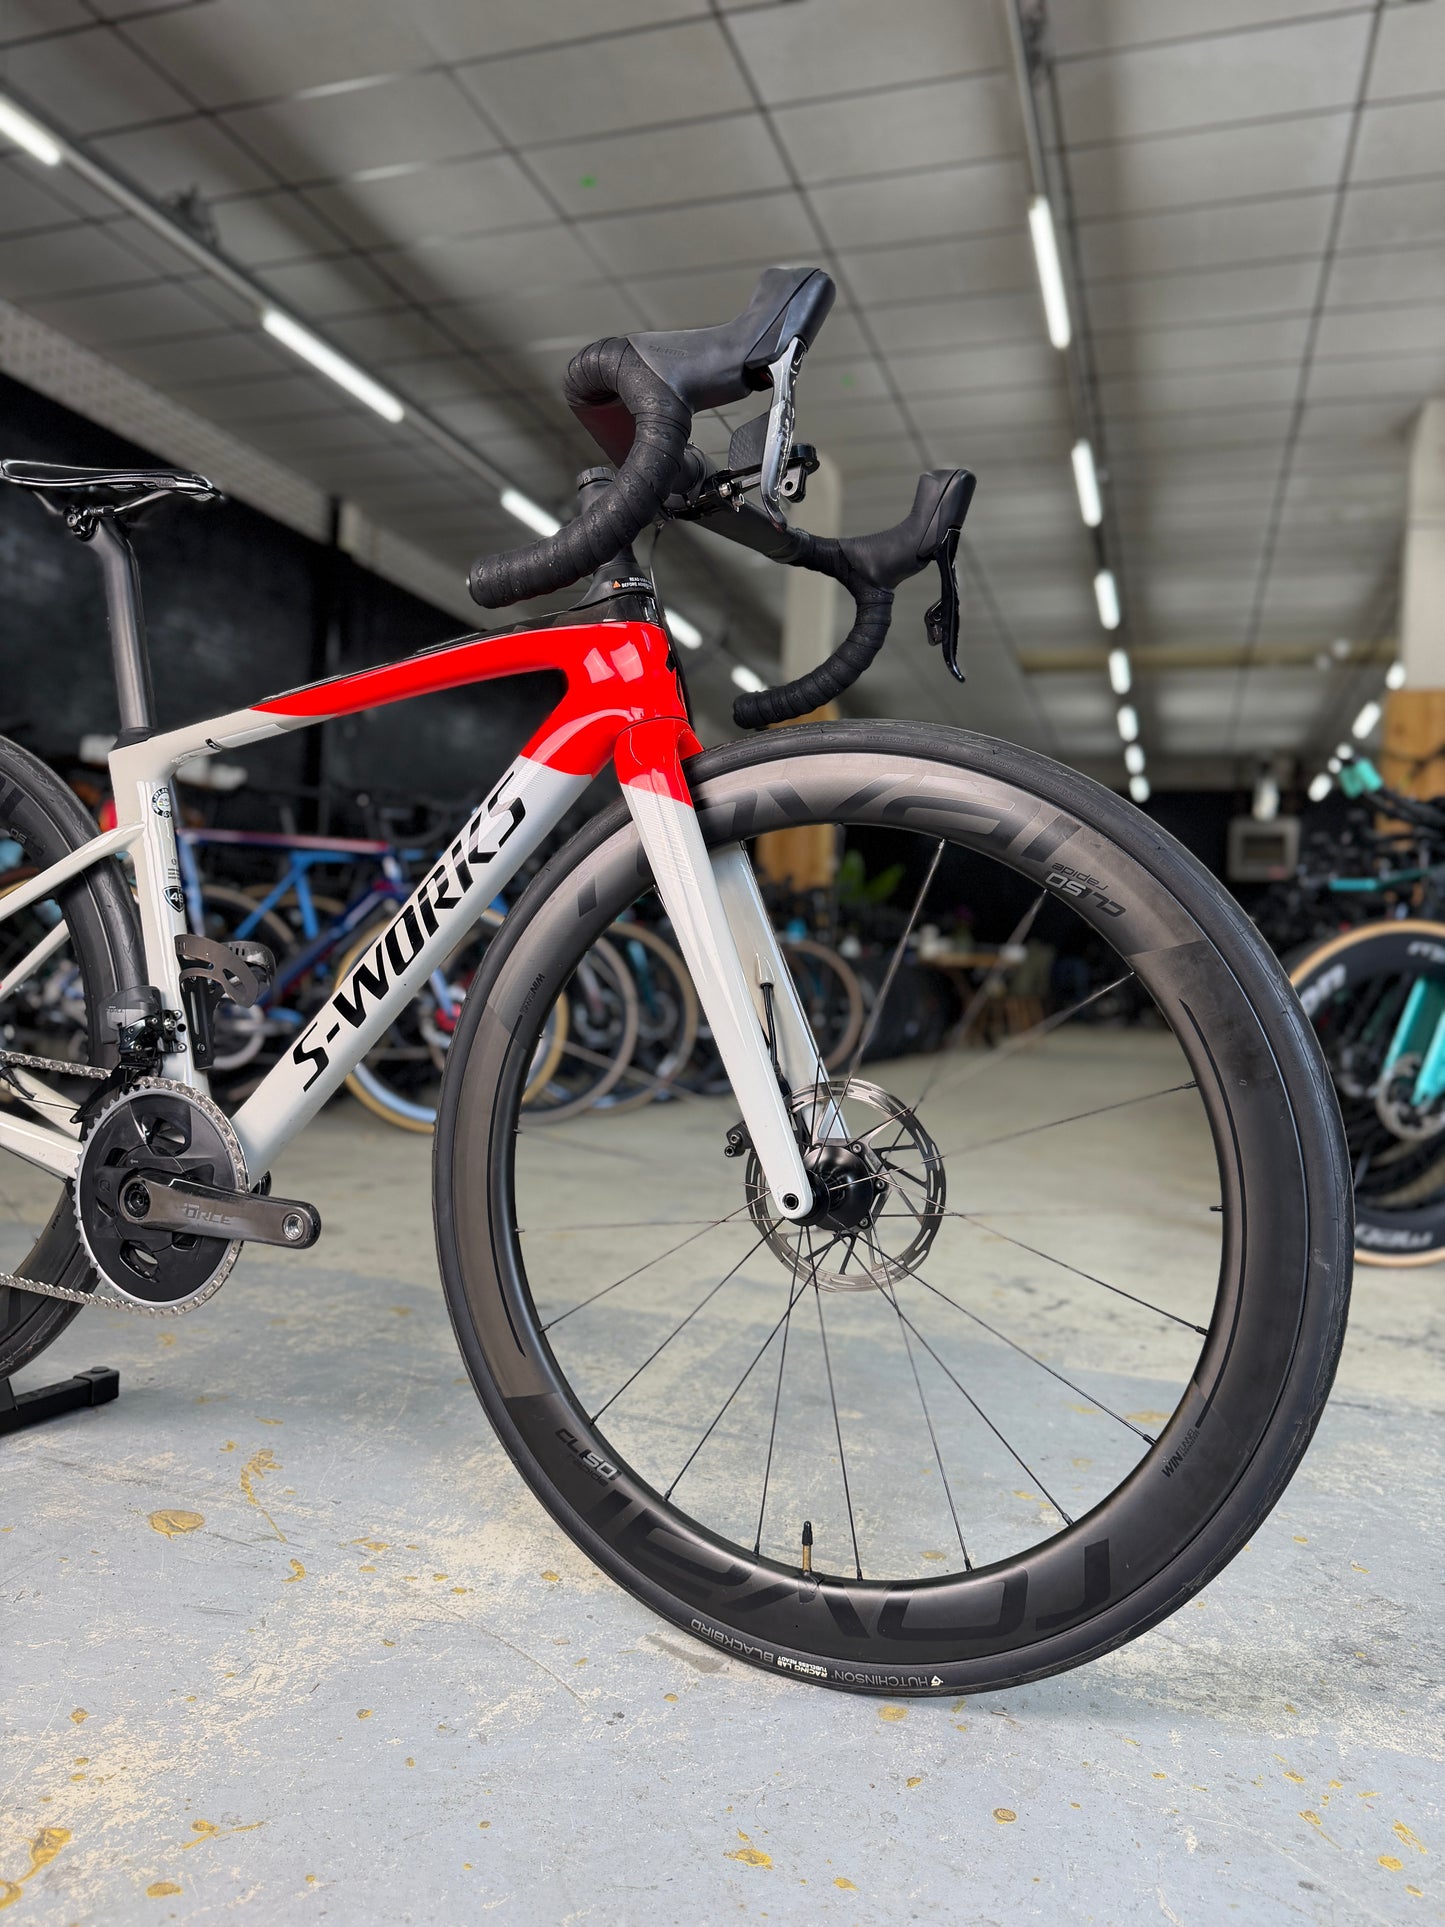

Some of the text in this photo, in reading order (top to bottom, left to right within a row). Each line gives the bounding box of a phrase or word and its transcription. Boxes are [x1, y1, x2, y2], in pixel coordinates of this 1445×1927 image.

[1051, 862, 1109, 891] rapide
[293, 771, 526, 1092] S-WORKS
[690, 1618, 775, 1663] BLACKBIRD
[776, 1659, 828, 1678] RACING LAB
[833, 1669, 929, 1687] HUTCHINSON
